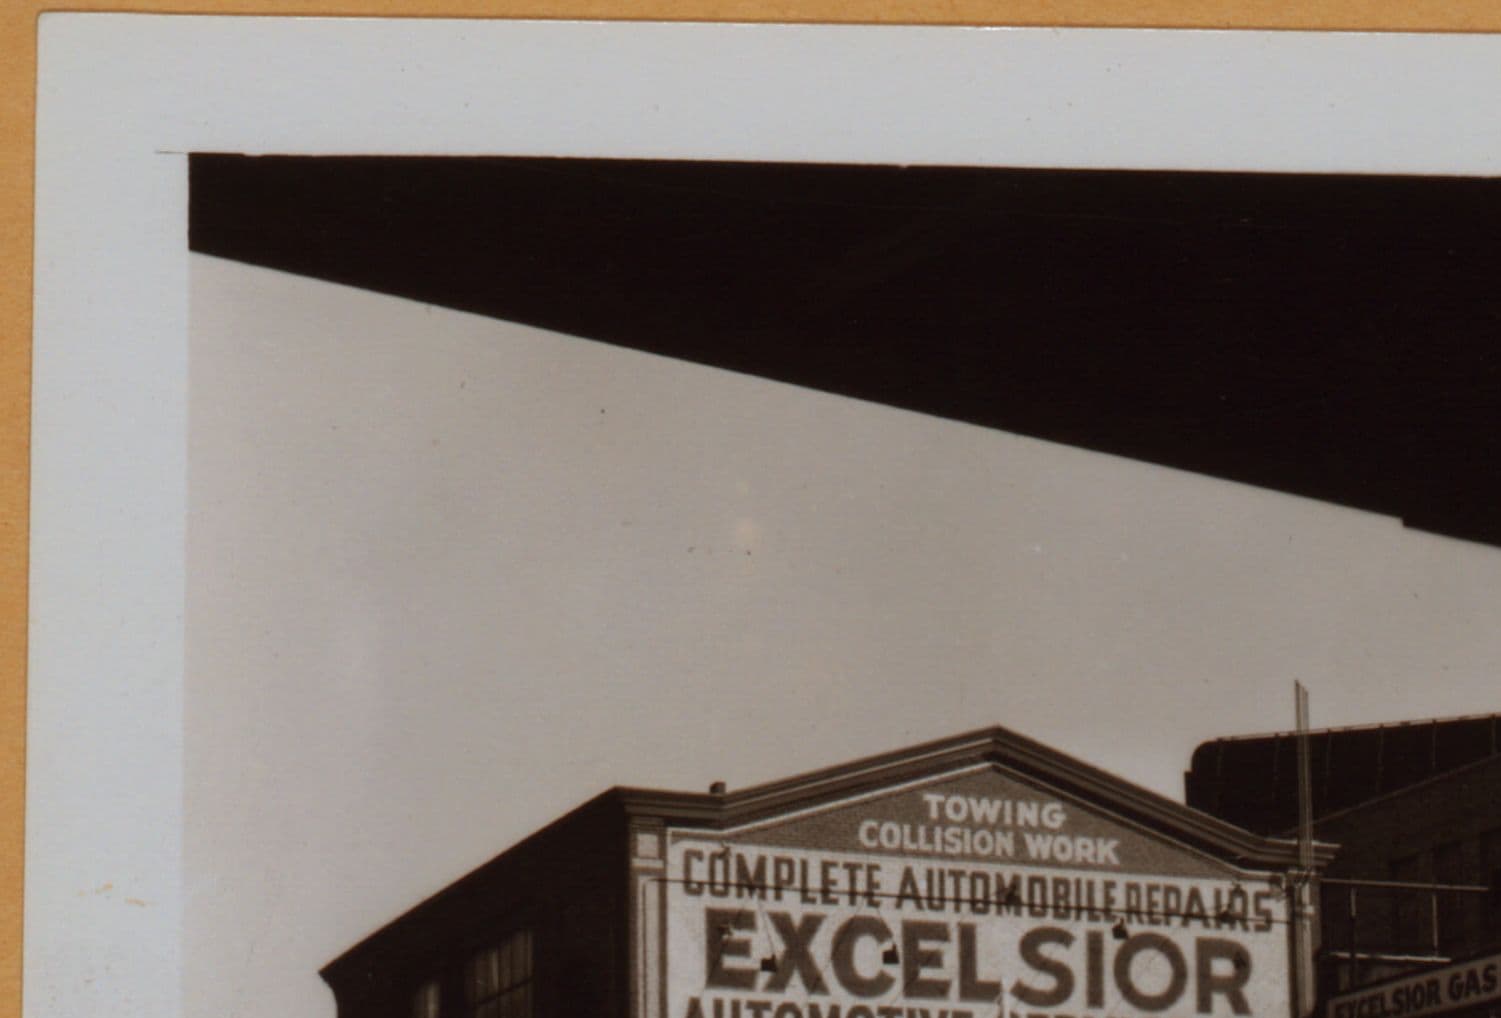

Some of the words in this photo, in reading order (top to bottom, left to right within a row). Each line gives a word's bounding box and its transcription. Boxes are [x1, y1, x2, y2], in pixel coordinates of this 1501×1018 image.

[922, 794, 1066, 829] TOWING
[858, 820, 1015, 857] COLLISION
[1024, 832, 1120, 865] WORK
[682, 848, 881, 908] COMPLETE
[895, 866, 1117, 923] AUTOMOBILE
[1126, 882, 1273, 933] REPAIRS
[705, 907, 1254, 1016] EXCELSIOR
[1447, 964, 1498, 1001] GAS
